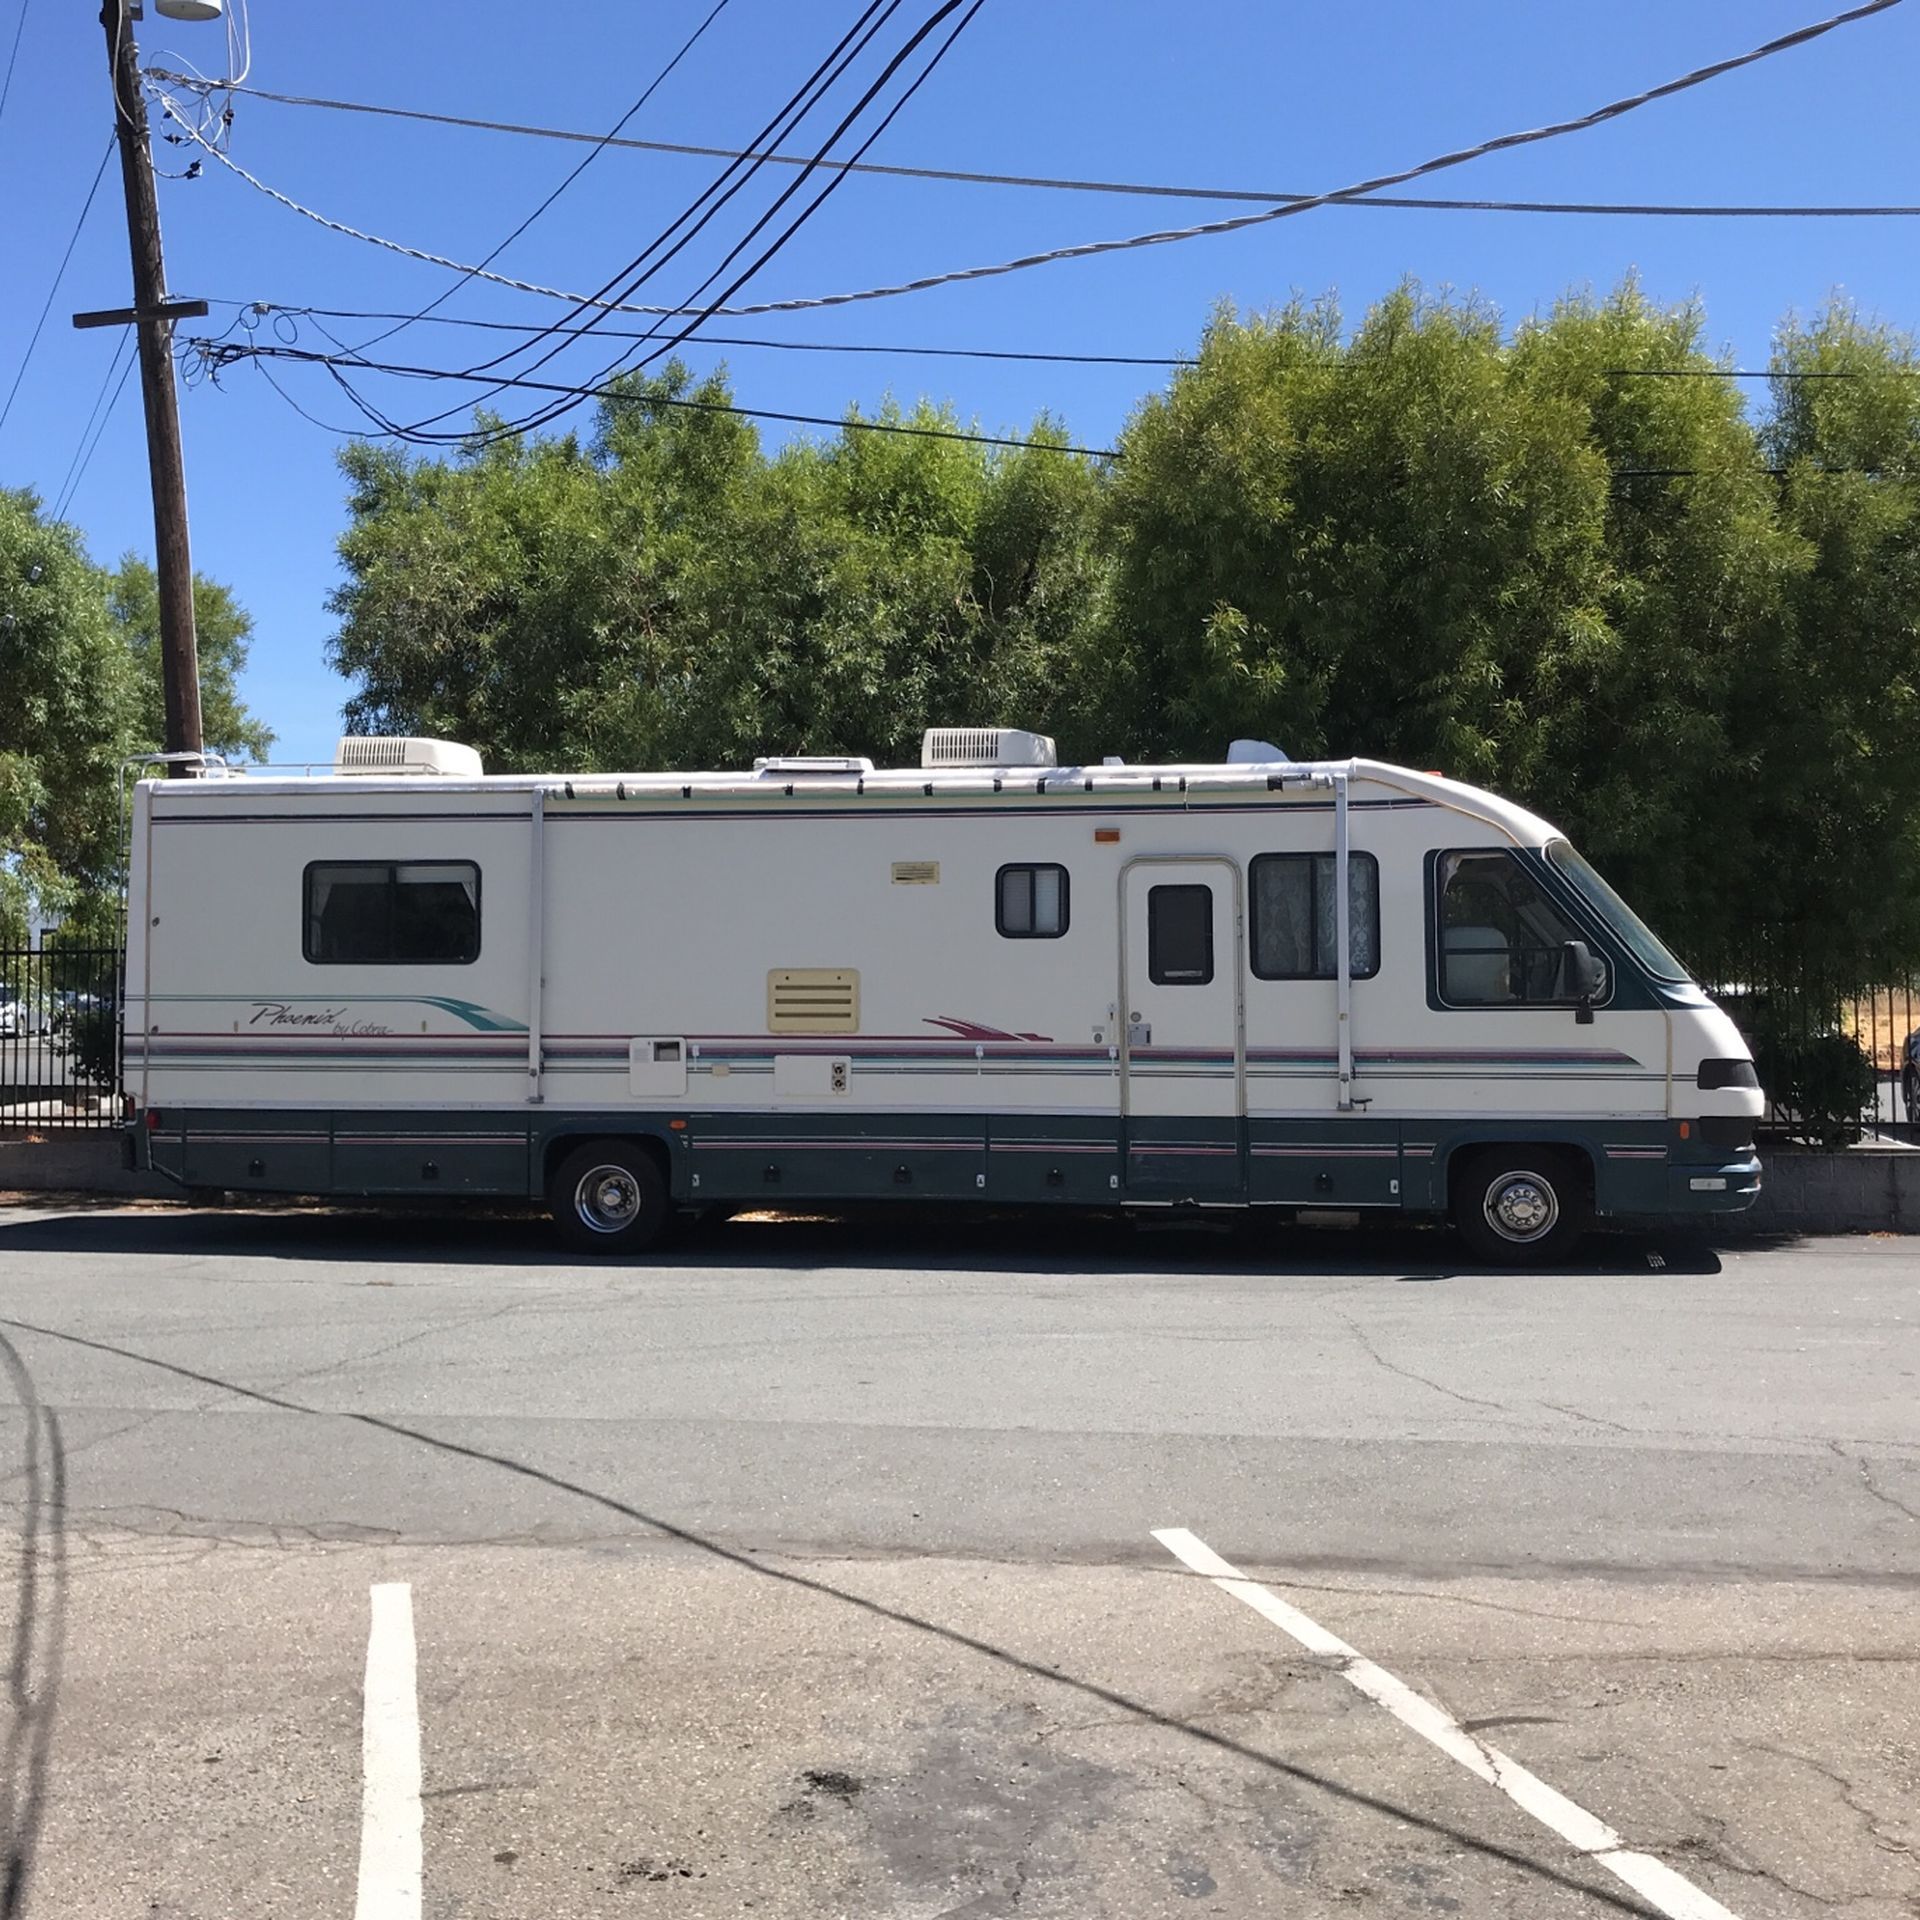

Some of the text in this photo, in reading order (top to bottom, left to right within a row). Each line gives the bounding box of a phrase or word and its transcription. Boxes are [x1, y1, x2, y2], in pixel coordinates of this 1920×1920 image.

[249, 1003, 347, 1026] Phoenix
[333, 1020, 393, 1040] by Cobra
